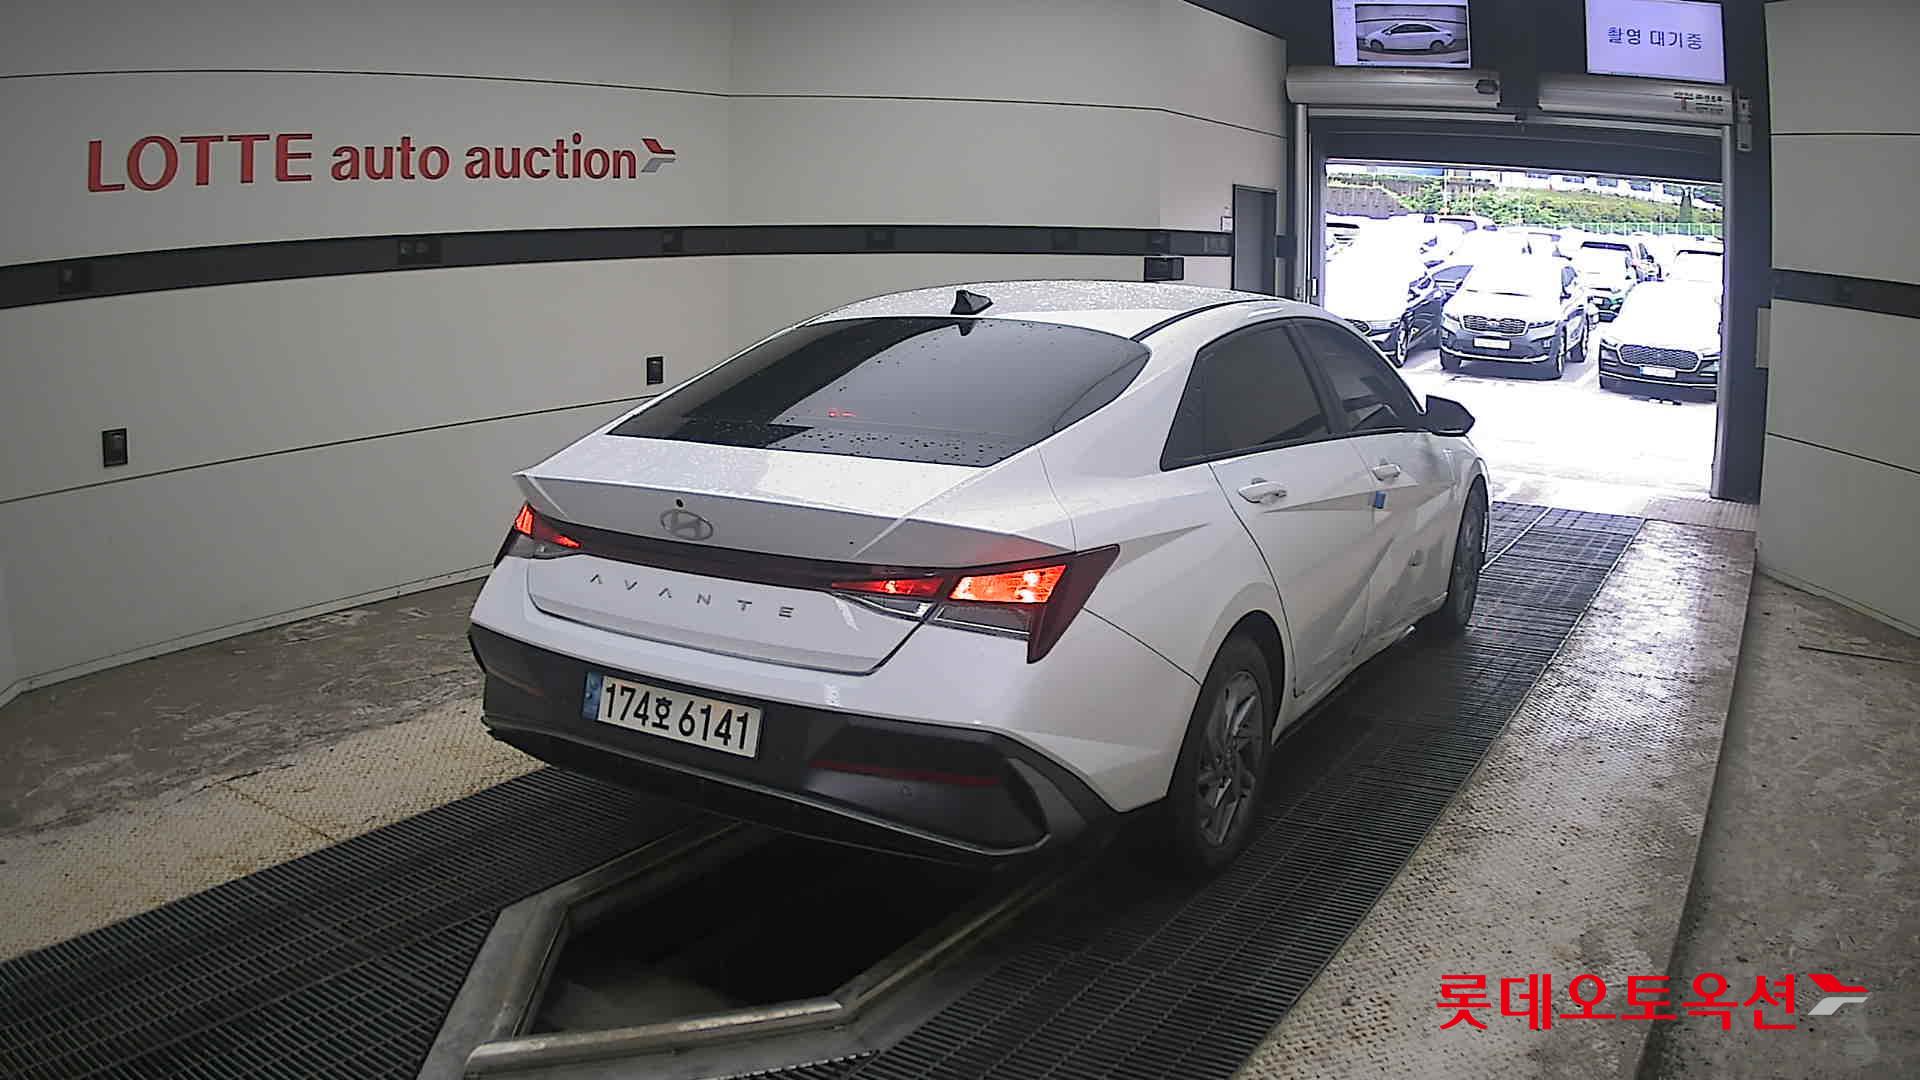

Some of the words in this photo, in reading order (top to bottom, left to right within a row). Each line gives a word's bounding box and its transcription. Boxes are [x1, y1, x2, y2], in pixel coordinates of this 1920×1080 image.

[1608, 26, 1641, 46] 촬영
[1650, 30, 1703, 50] 대기중
[88, 133, 313, 193] LOTTE
[331, 136, 450, 180] auto
[464, 132, 637, 180] auction
[589, 573, 795, 618] AVANTE
[678, 700, 749, 750] 6141
